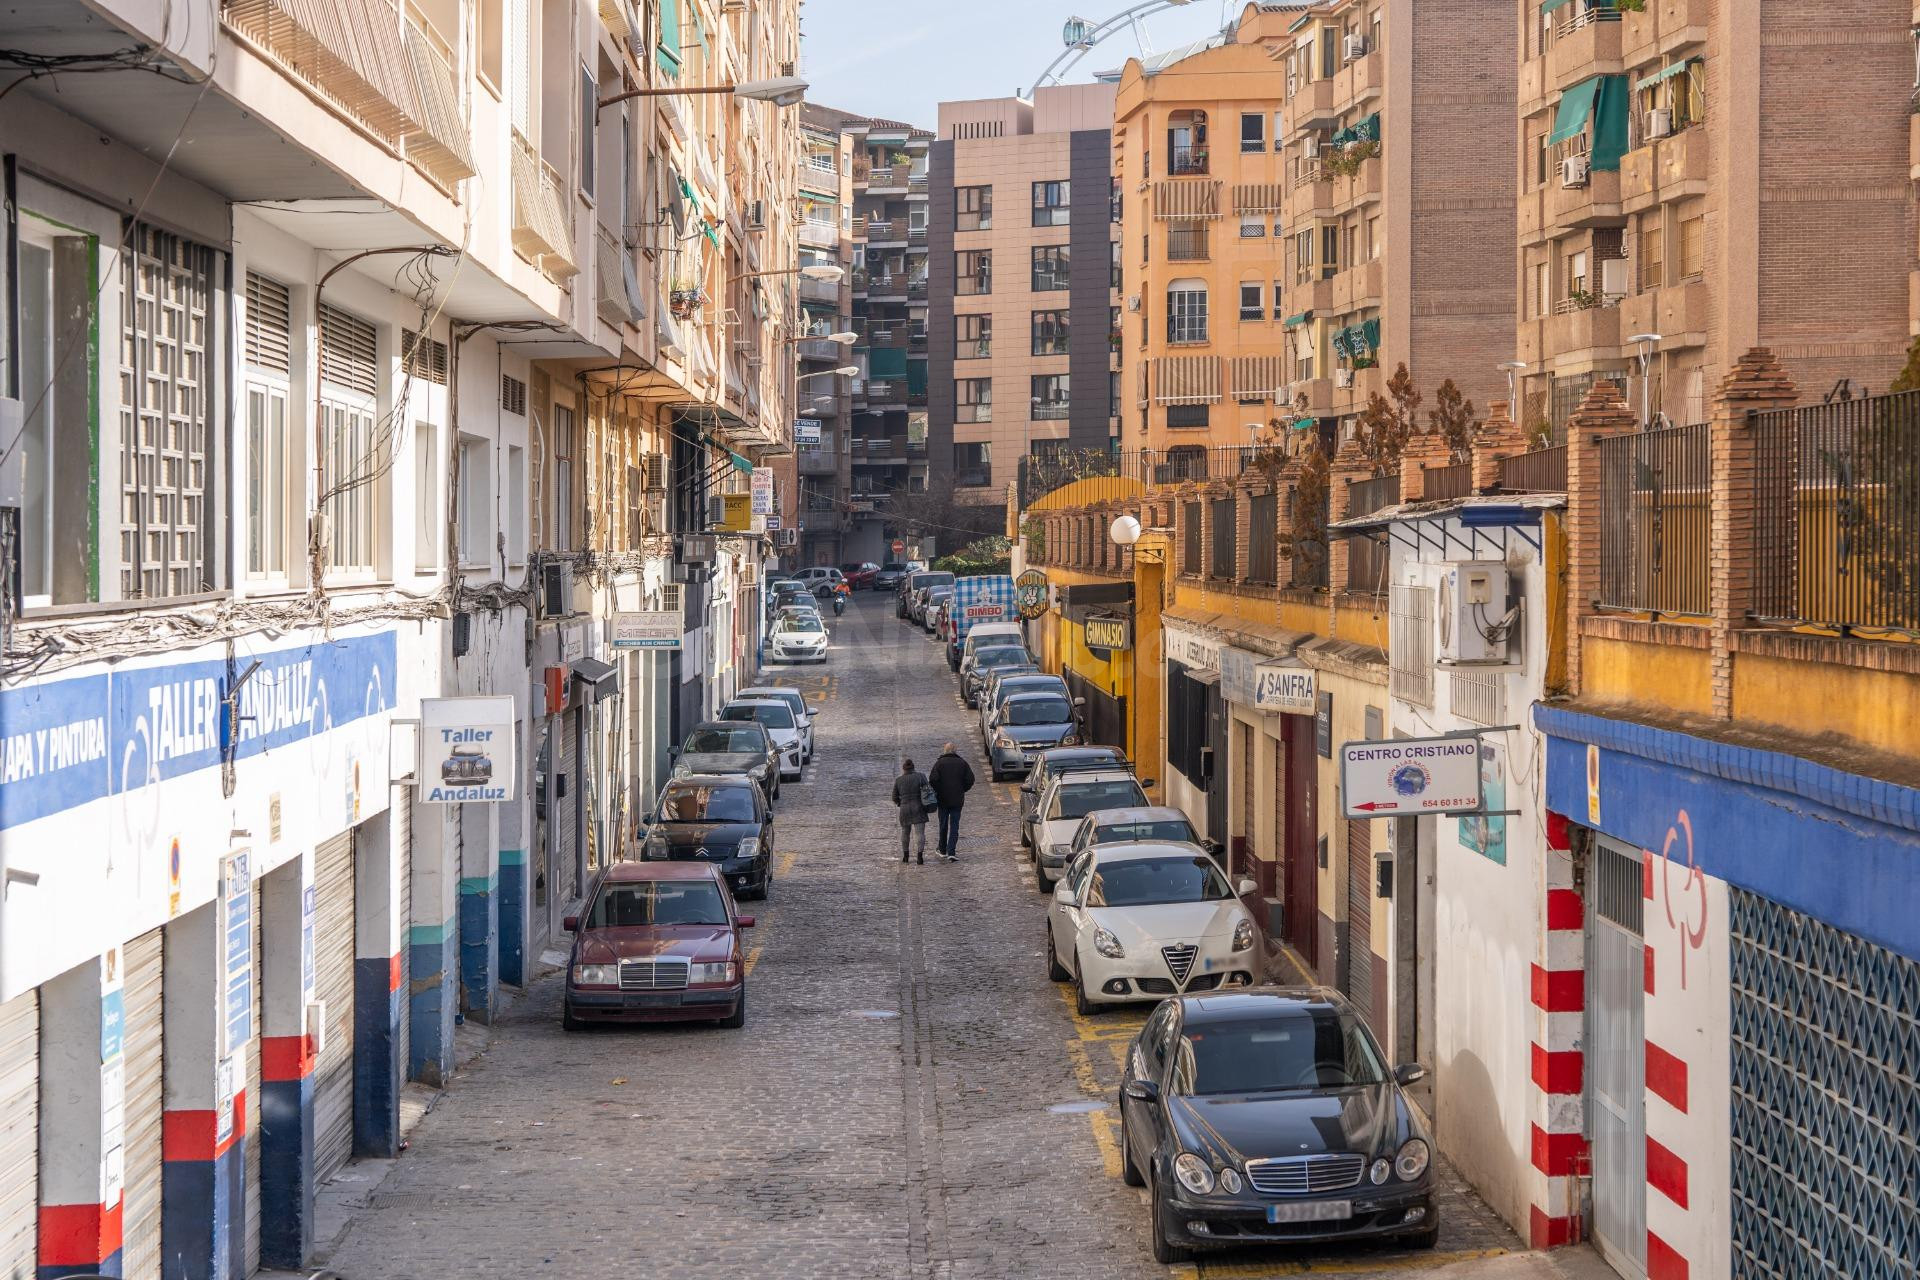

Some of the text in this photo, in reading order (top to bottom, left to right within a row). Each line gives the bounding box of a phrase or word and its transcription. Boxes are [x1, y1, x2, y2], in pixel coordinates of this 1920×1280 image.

[967, 606, 1002, 617] BIMBO
[617, 615, 677, 626] AIXAM
[616, 628, 678, 639] MEGA
[1086, 621, 1124, 647] GIMNASIO
[1267, 672, 1314, 698] SANFRA
[149, 660, 312, 765] TALLER ANDALUZ
[441, 728, 493, 743] Taller
[36, 729, 48, 775] Y
[49, 717, 106, 772] PINTURA
[1348, 744, 1475, 762] CENTRO CRISTIANO
[428, 785, 505, 801] Andaluz
[1422, 797, 1476, 808] 654 60 81 34
